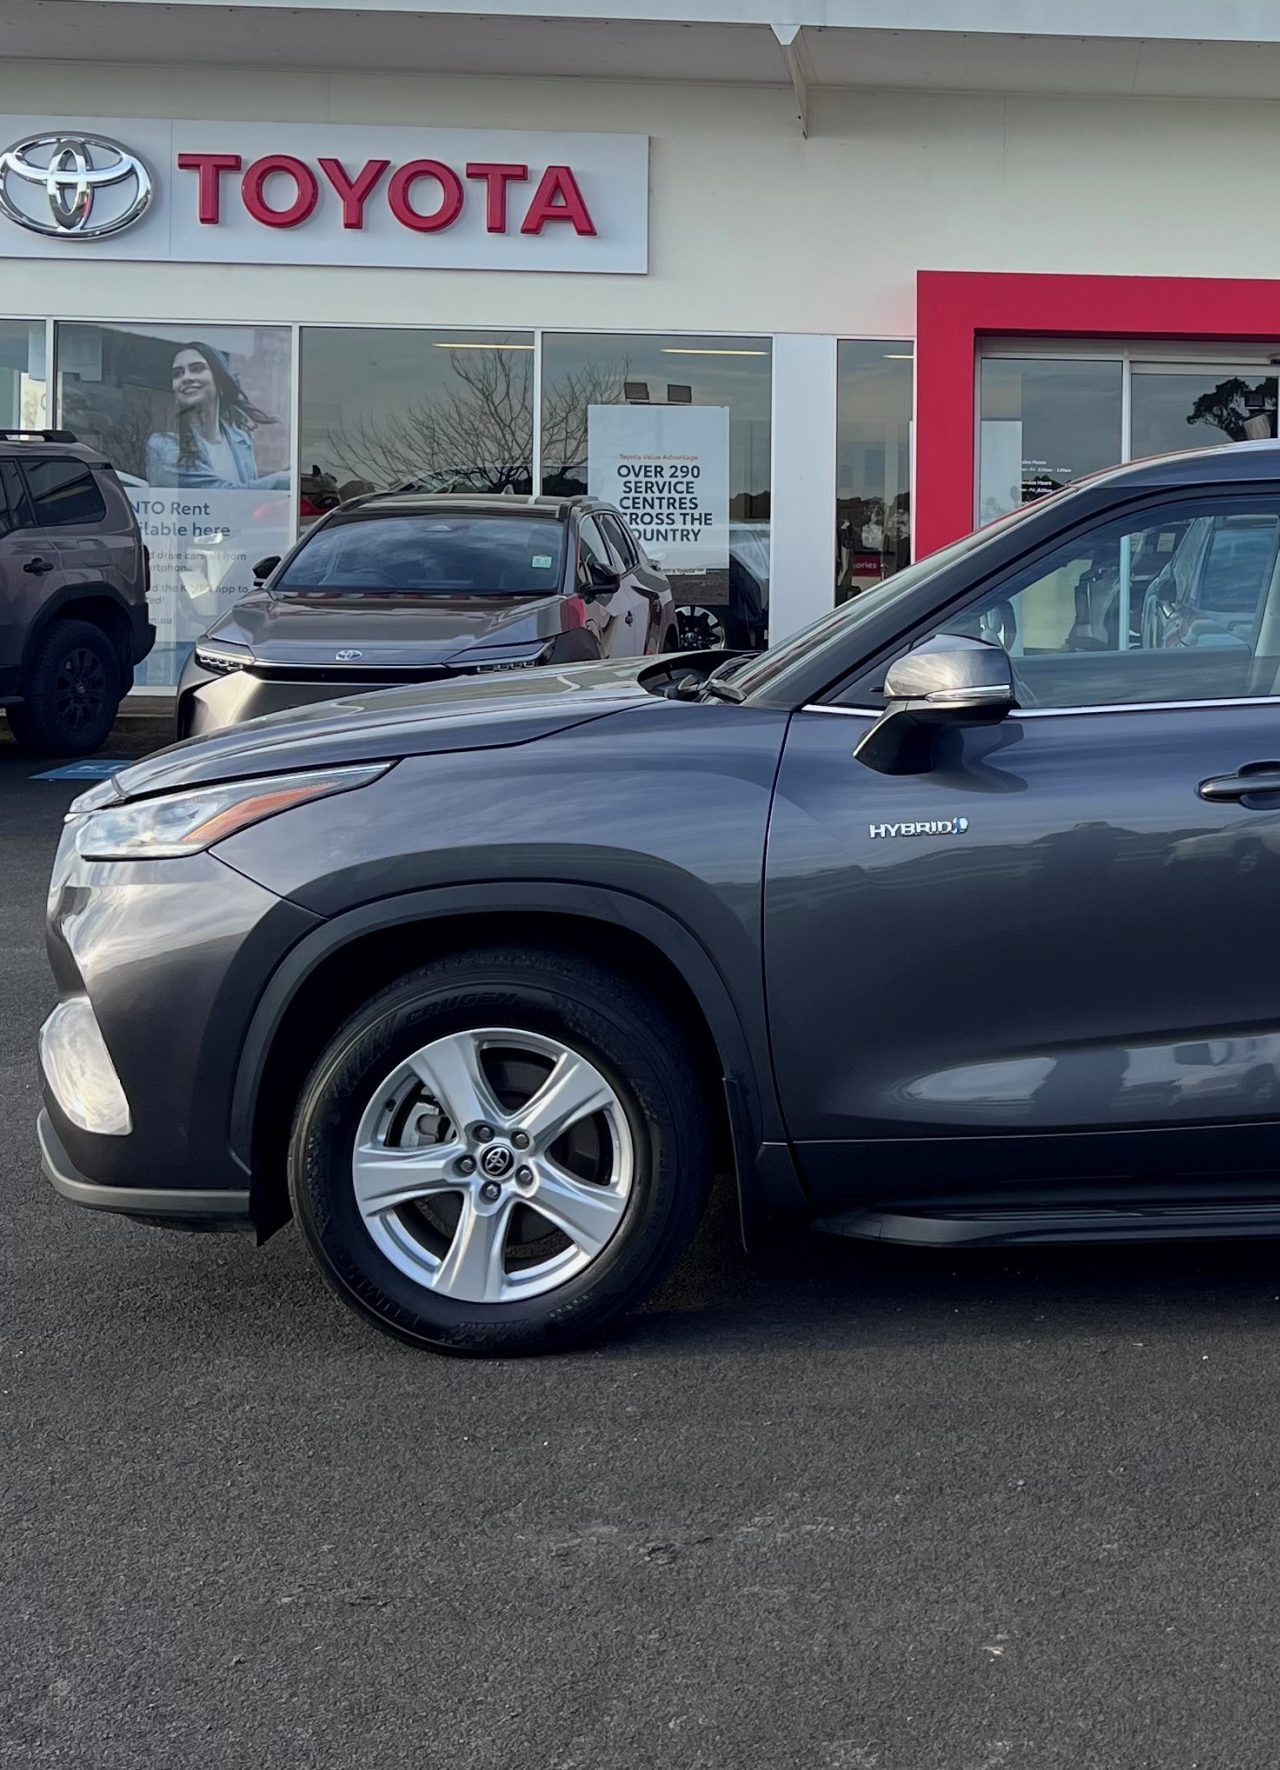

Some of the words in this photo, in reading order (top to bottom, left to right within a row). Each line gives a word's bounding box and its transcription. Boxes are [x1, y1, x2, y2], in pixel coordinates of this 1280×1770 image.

[177, 152, 597, 237] TOYOTA
[617, 465, 664, 478] OVER
[669, 465, 700, 478] 290
[622, 481, 695, 494] SERVICE
[132, 501, 165, 514] NTO
[171, 502, 210, 515] Rent
[619, 497, 698, 510] CENTRES
[622, 512, 675, 525] ROSS
[680, 513, 713, 526] THE
[139, 521, 187, 536] ilable
[192, 522, 230, 536] here
[631, 528, 701, 541] OUNTRY
[157, 551, 182, 560] drive
[216, 586, 235, 595] app
[238, 585, 249, 593] to
[869, 820, 952, 838] HYBRID
